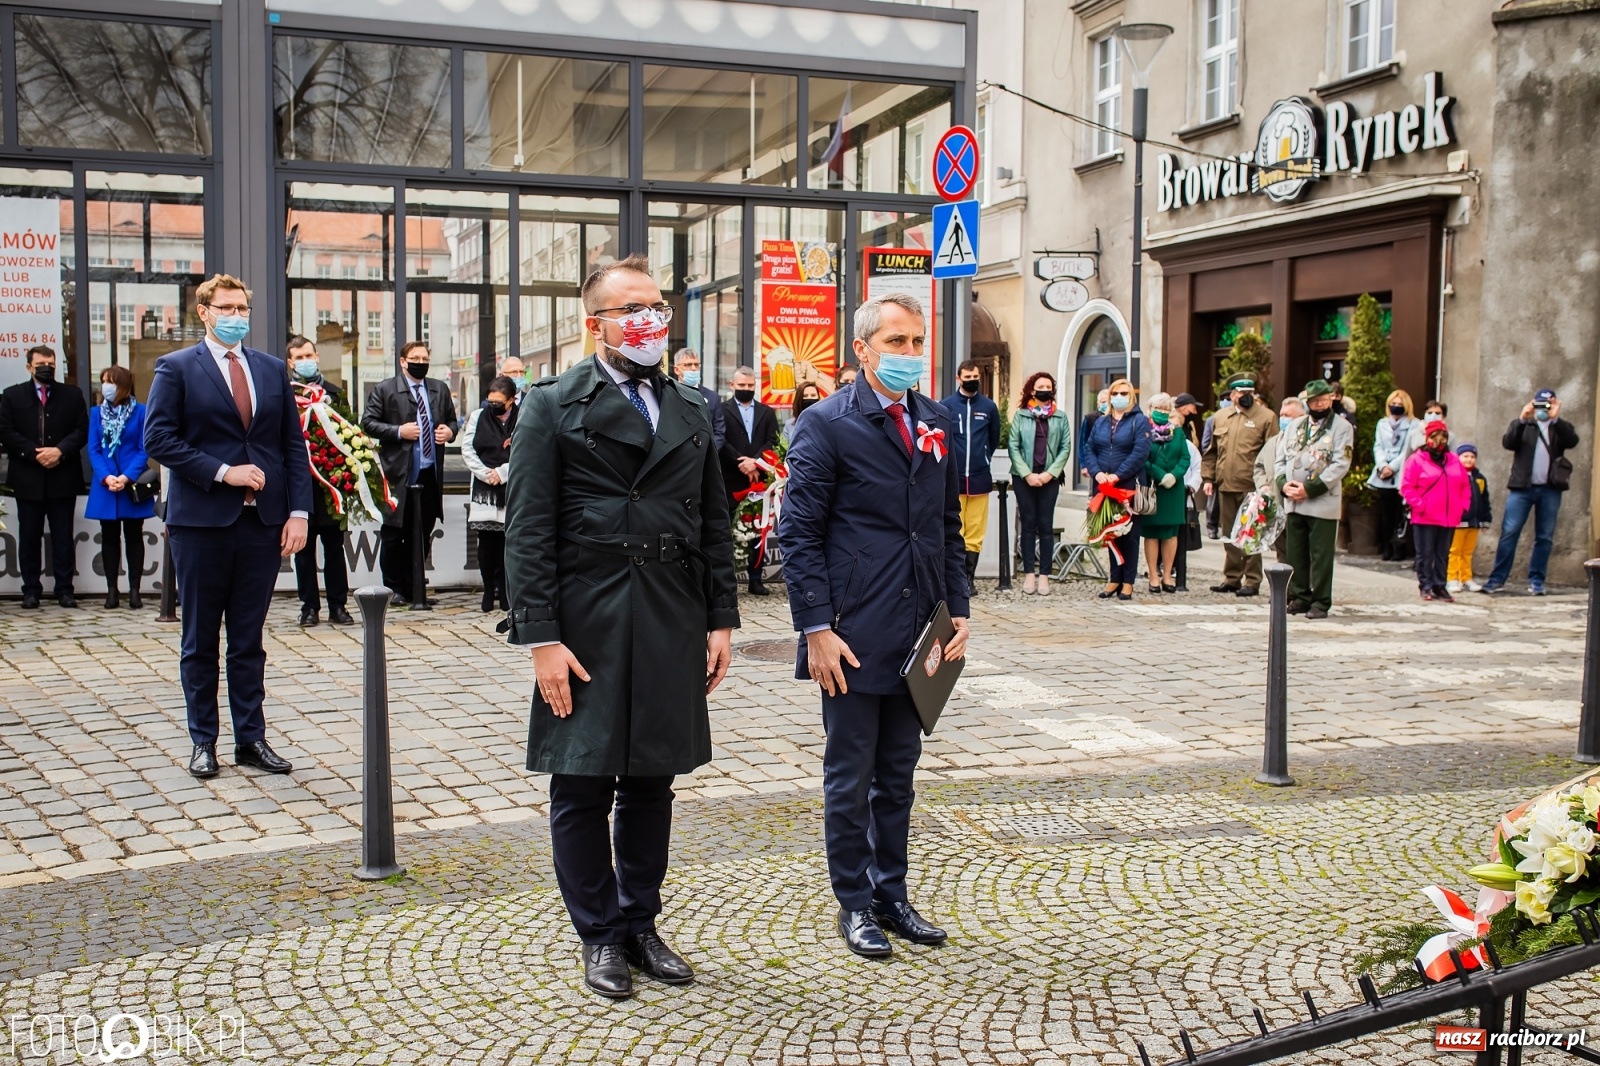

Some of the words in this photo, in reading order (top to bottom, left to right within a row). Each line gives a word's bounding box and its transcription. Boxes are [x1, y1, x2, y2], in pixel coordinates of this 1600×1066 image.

[1157, 150, 1254, 213] Browar
[1325, 71, 1451, 178] Rynek
[0, 229, 57, 250] MÓW
[763, 243, 778, 251] Pizza
[780, 243, 794, 252] Time
[763, 254, 781, 265] Druga
[782, 255, 797, 265] pizza
[878, 254, 925, 268] LUNCH
[771, 265, 793, 277] gratis!
[4, 272, 30, 283] LUB
[772, 286, 828, 307] Promocja
[0, 303, 52, 314] LOKALU
[780, 307, 798, 315] DWA
[776, 316, 797, 324] CENIE
[798, 317, 831, 325] JEDNEGO
[0, 333, 17, 343] 415
[22, 333, 37, 343] 84
[41, 333, 56, 343] 84
[1, 348, 19, 358] 415
